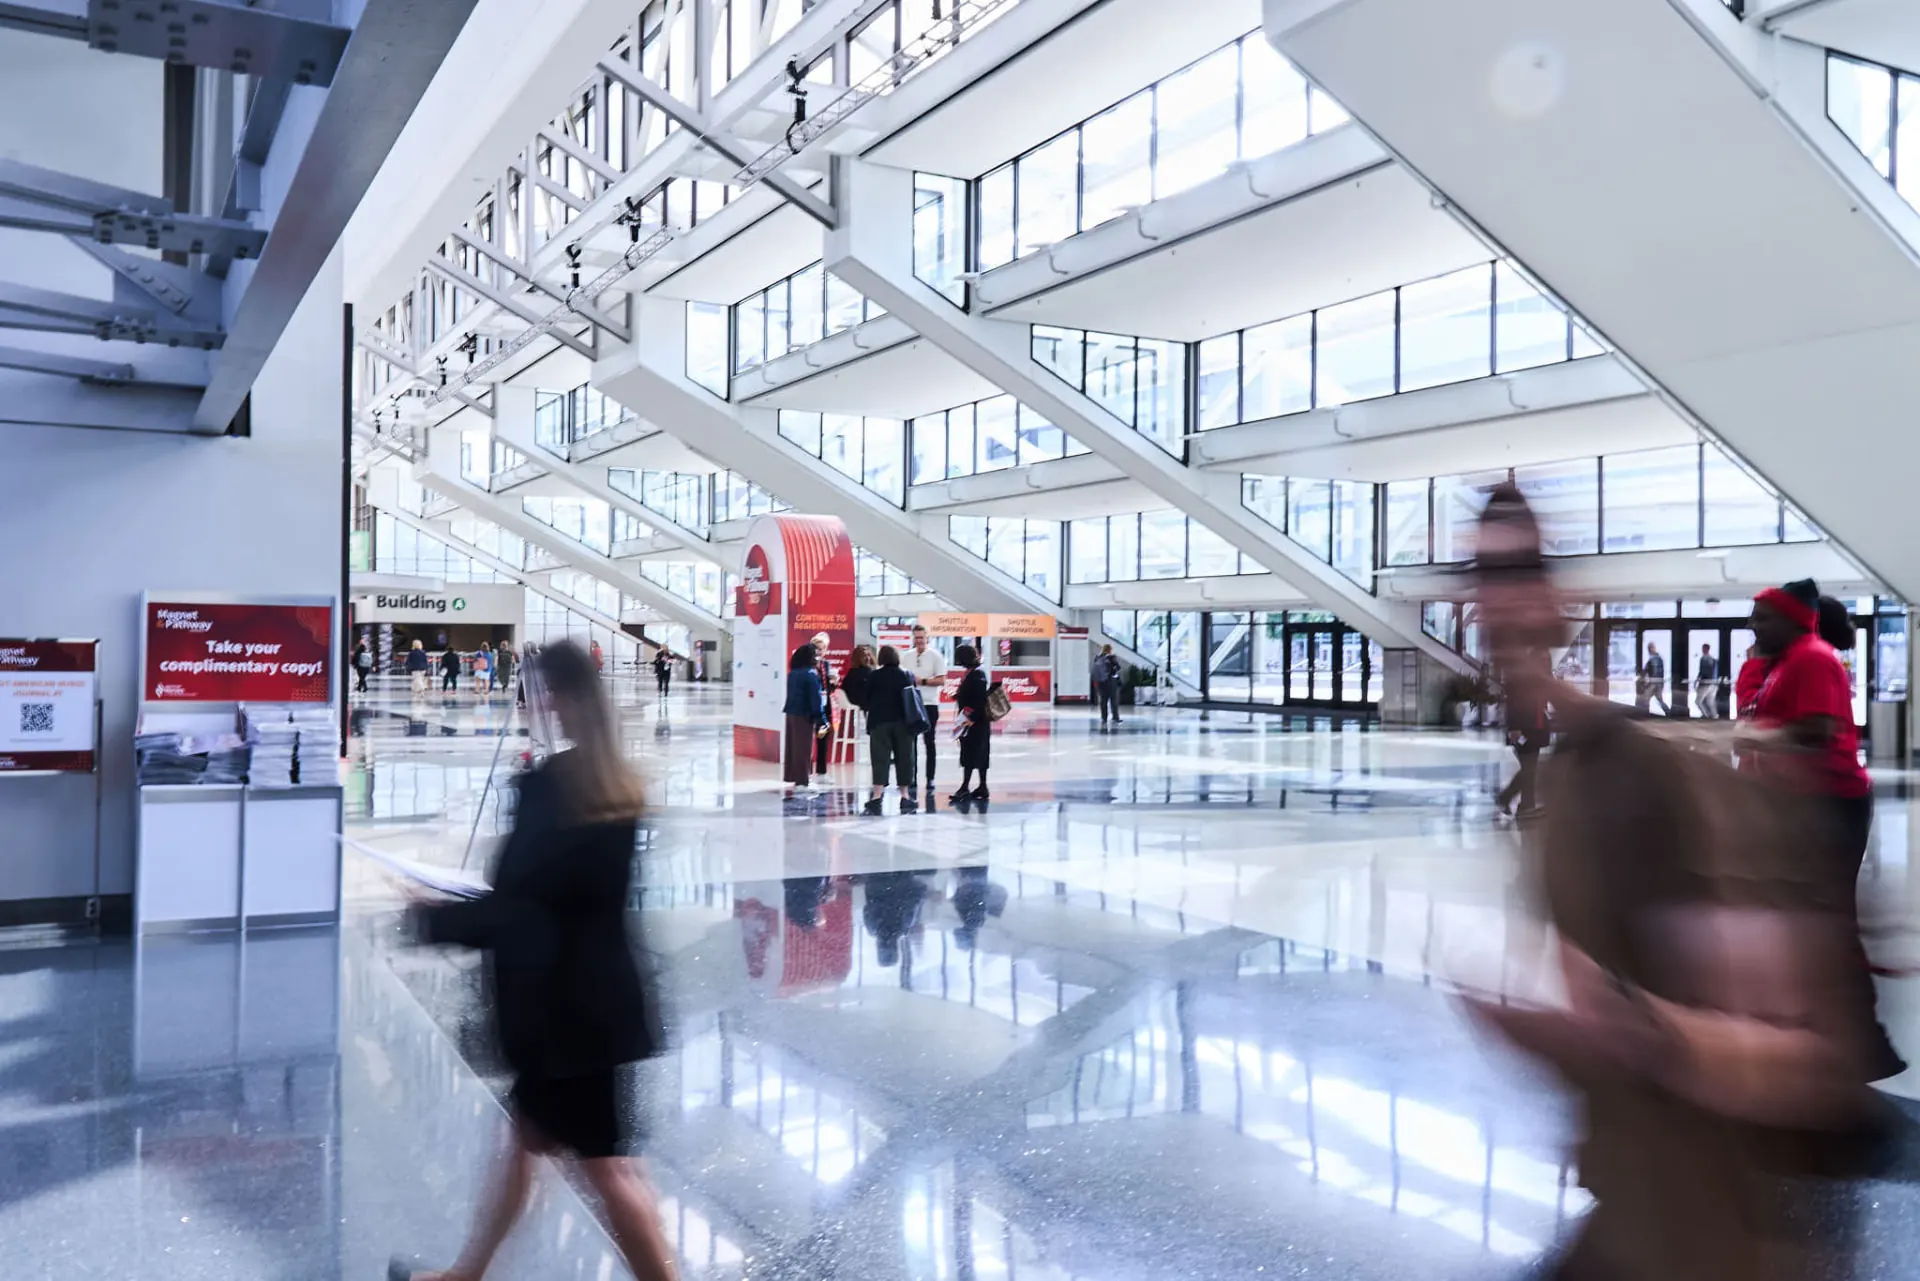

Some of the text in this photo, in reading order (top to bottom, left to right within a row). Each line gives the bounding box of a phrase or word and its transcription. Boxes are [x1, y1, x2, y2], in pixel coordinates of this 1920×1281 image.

[376, 594, 466, 613] Building A
[157, 609, 199, 621] Magnet
[795, 614, 848, 622] CONTINUE TO
[164, 619, 214, 632] Pathway
[793, 622, 849, 630] REGISTRATION
[205, 640, 282, 656] Take your
[159, 658, 323, 676] complimentary copy!
